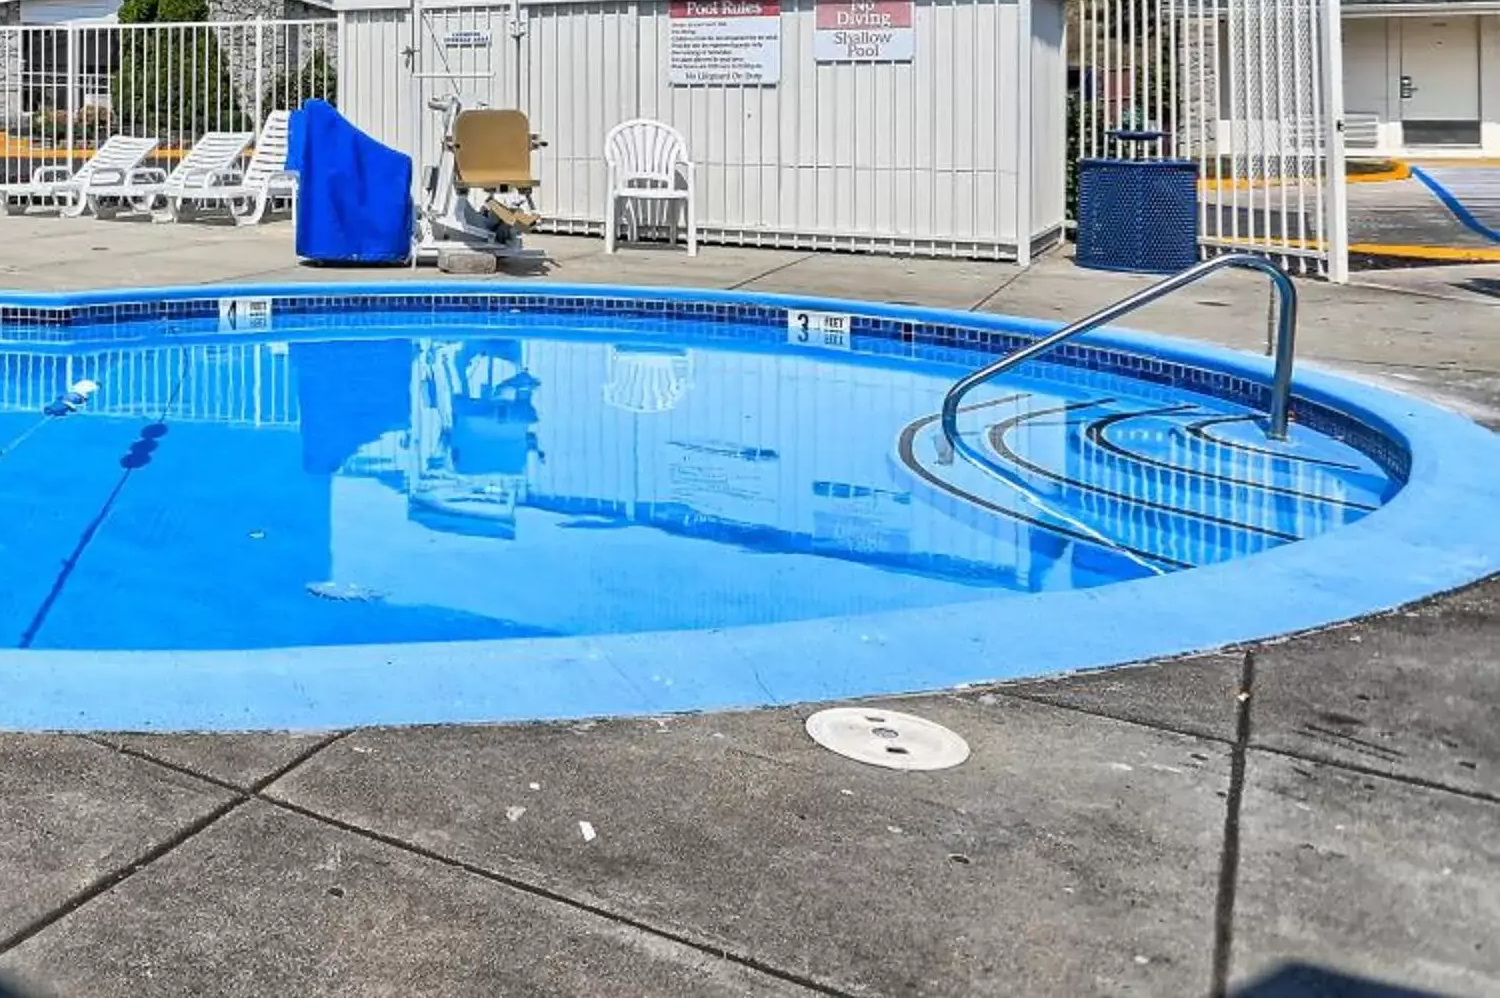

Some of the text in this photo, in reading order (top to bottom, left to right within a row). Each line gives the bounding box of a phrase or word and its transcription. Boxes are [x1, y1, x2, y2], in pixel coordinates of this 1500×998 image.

[686, 0, 762, 15] Pool Rules
[836, 10, 892, 28] Diving
[834, 31, 893, 45] Shallow
[847, 44, 880, 58] Pool
[797, 313, 809, 330] 3
